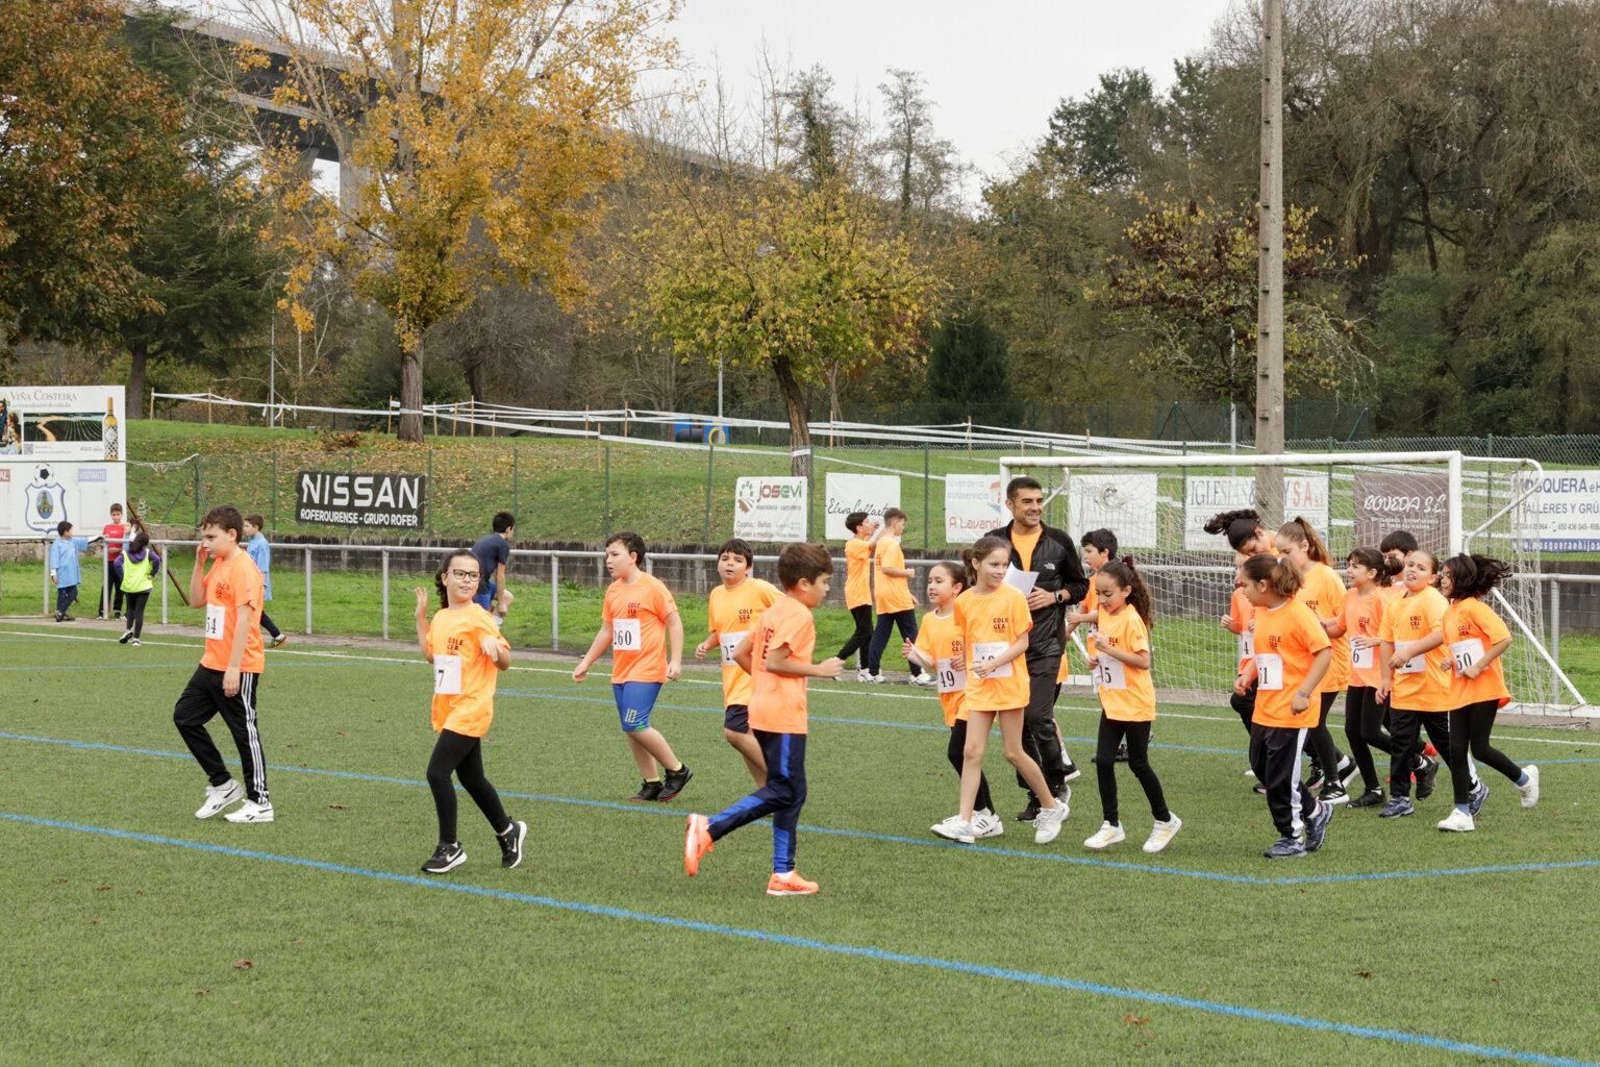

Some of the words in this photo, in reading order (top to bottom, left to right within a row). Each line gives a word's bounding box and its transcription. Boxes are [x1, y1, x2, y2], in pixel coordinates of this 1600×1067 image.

[302, 474, 419, 509] NISSAN
[757, 480, 802, 503] josevi
[1190, 480, 1248, 506] IGLESIAS
[300, 508, 358, 524] ROFEROURENSE
[363, 513, 390, 525] GRUPO
[390, 514, 418, 527] ROFER
[1570, 503, 1577, 514] Y
[448, 637, 463, 646] COLE
